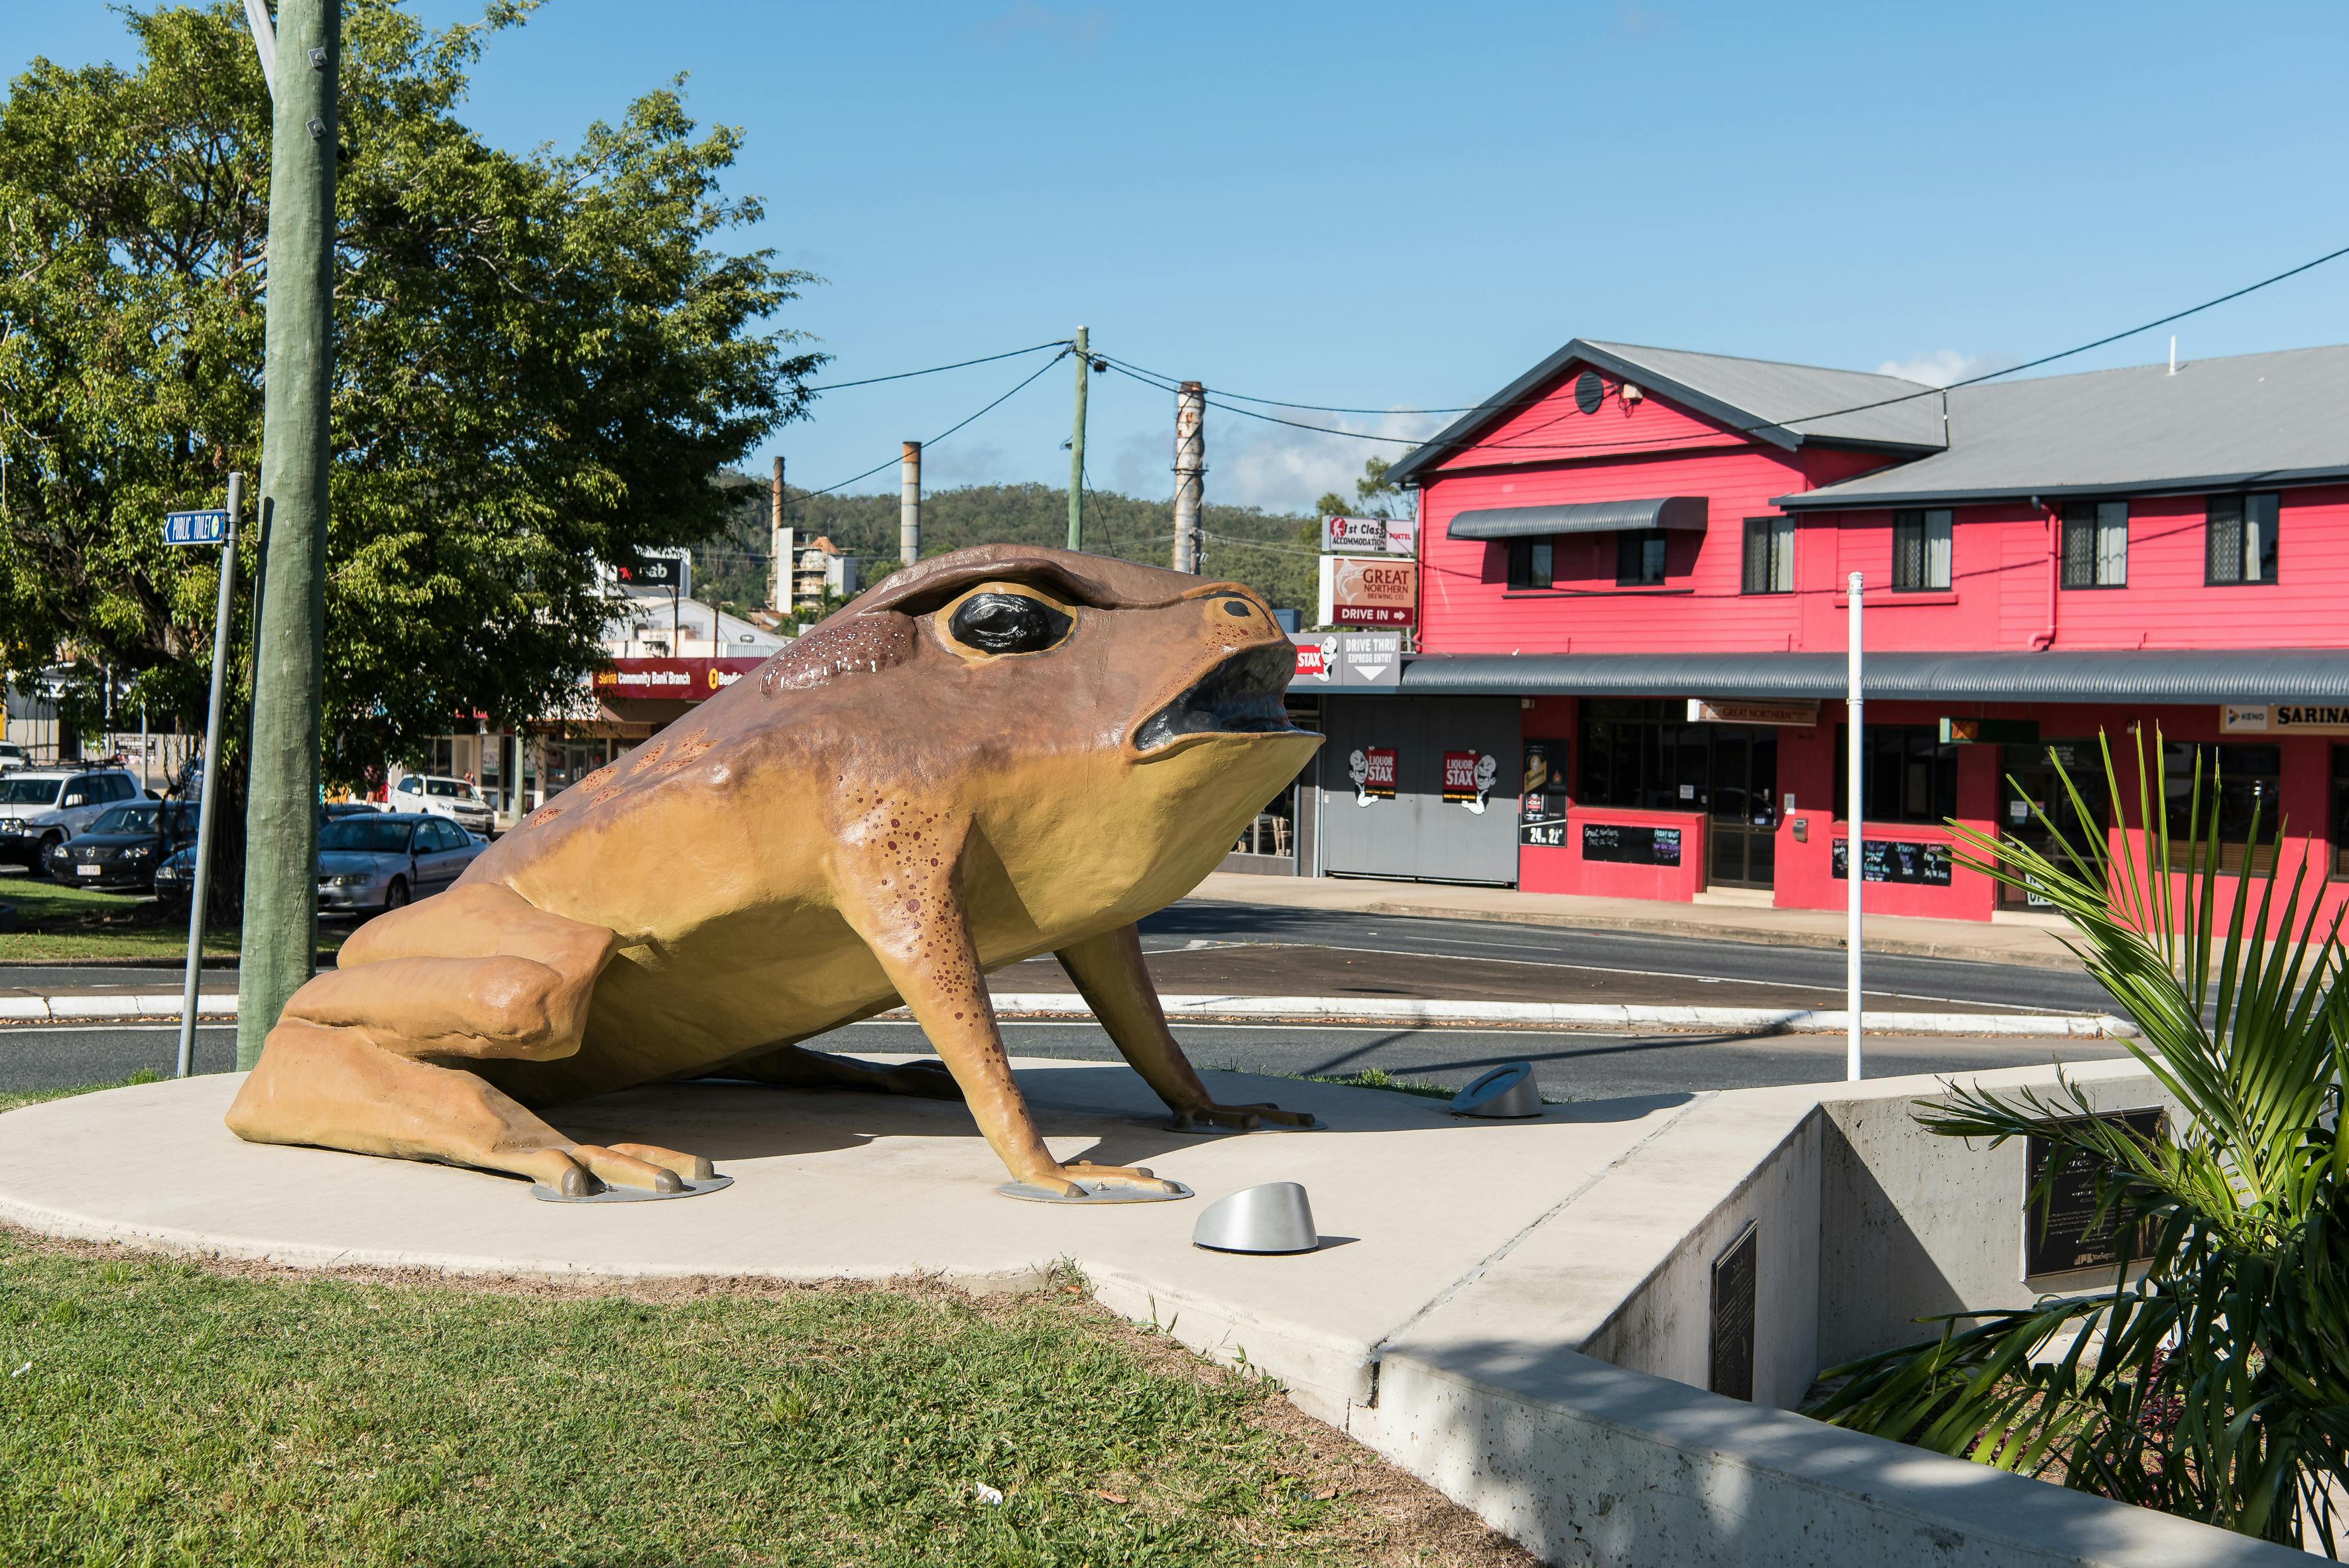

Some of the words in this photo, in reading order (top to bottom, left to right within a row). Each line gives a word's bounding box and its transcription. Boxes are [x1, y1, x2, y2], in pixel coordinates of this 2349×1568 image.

[172, 516, 191, 540] PUBLIC
[194, 514, 212, 540] TOILET
[1344, 524, 1357, 534] 1st
[1361, 524, 1384, 535] Class
[1332, 537, 1386, 548] ACCOMMODATION
[1362, 569, 1410, 585] GREAT
[1364, 583, 1408, 593] NORTHERN
[1341, 608, 1373, 620] DRIVE
[1376, 609, 1388, 621] IN
[1346, 638, 1371, 652] DRIVE
[1373, 638, 1396, 652] THRU
[1298, 652, 1321, 667] STAX
[1348, 653, 1372, 664] EXPRESS
[1373, 653, 1392, 664] ENTRY
[617, 671, 650, 688] Community
[668, 671, 690, 685] Branch
[1722, 707, 1748, 717] GREAT
[1750, 709, 1791, 719] NORTHERN
[2241, 711, 2264, 721] KENO
[2277, 706, 2349, 725] SARINA
[1368, 755, 1394, 766] LIQUOR
[1446, 758, 1474, 770] LIQUOR
[1368, 765, 1393, 782] STAX
[1446, 769, 1473, 786] STAX
